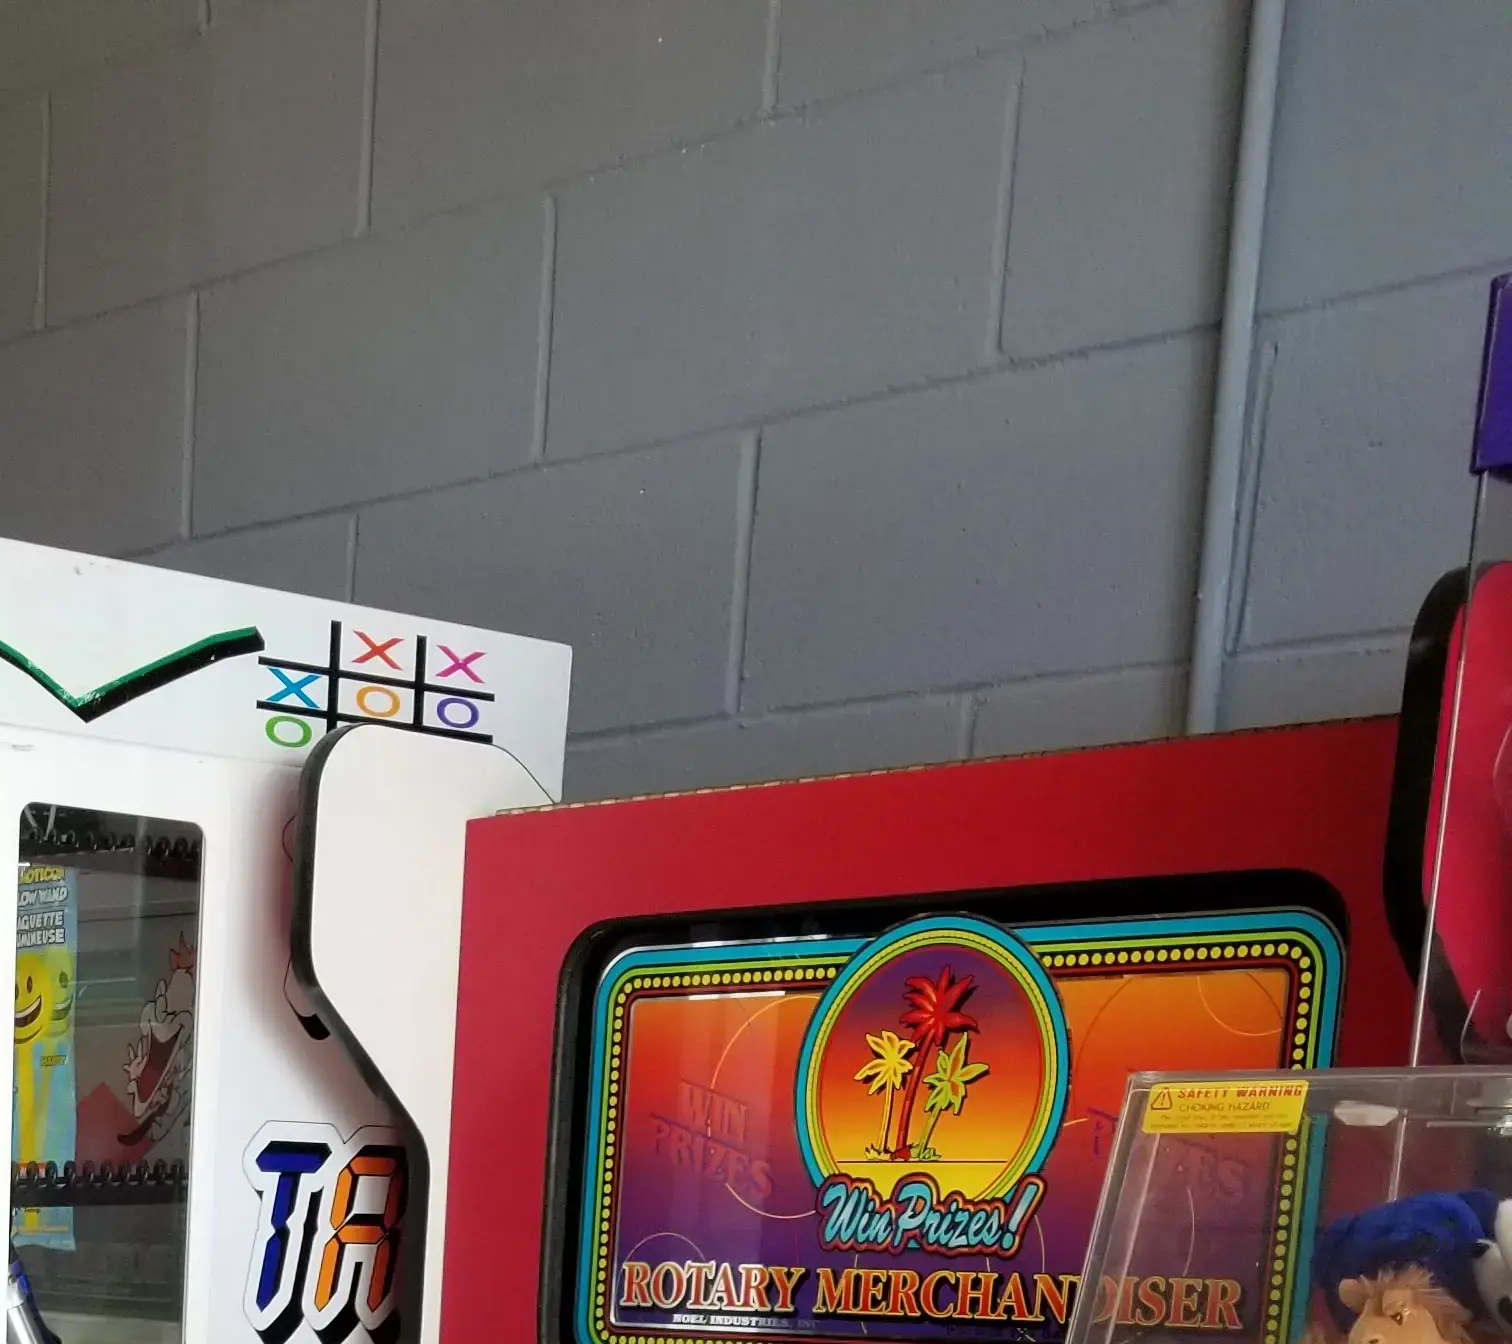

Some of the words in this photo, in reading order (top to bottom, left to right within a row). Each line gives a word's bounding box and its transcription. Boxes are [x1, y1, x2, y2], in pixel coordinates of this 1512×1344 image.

[1179, 1103, 1224, 1112] CHOKING
[1228, 1102, 1270, 1111] HAZARD
[1236, 1085, 1303, 1097] WARNING
[822, 1174, 895, 1246] Win
[619, 1259, 806, 1311] ROTARY
